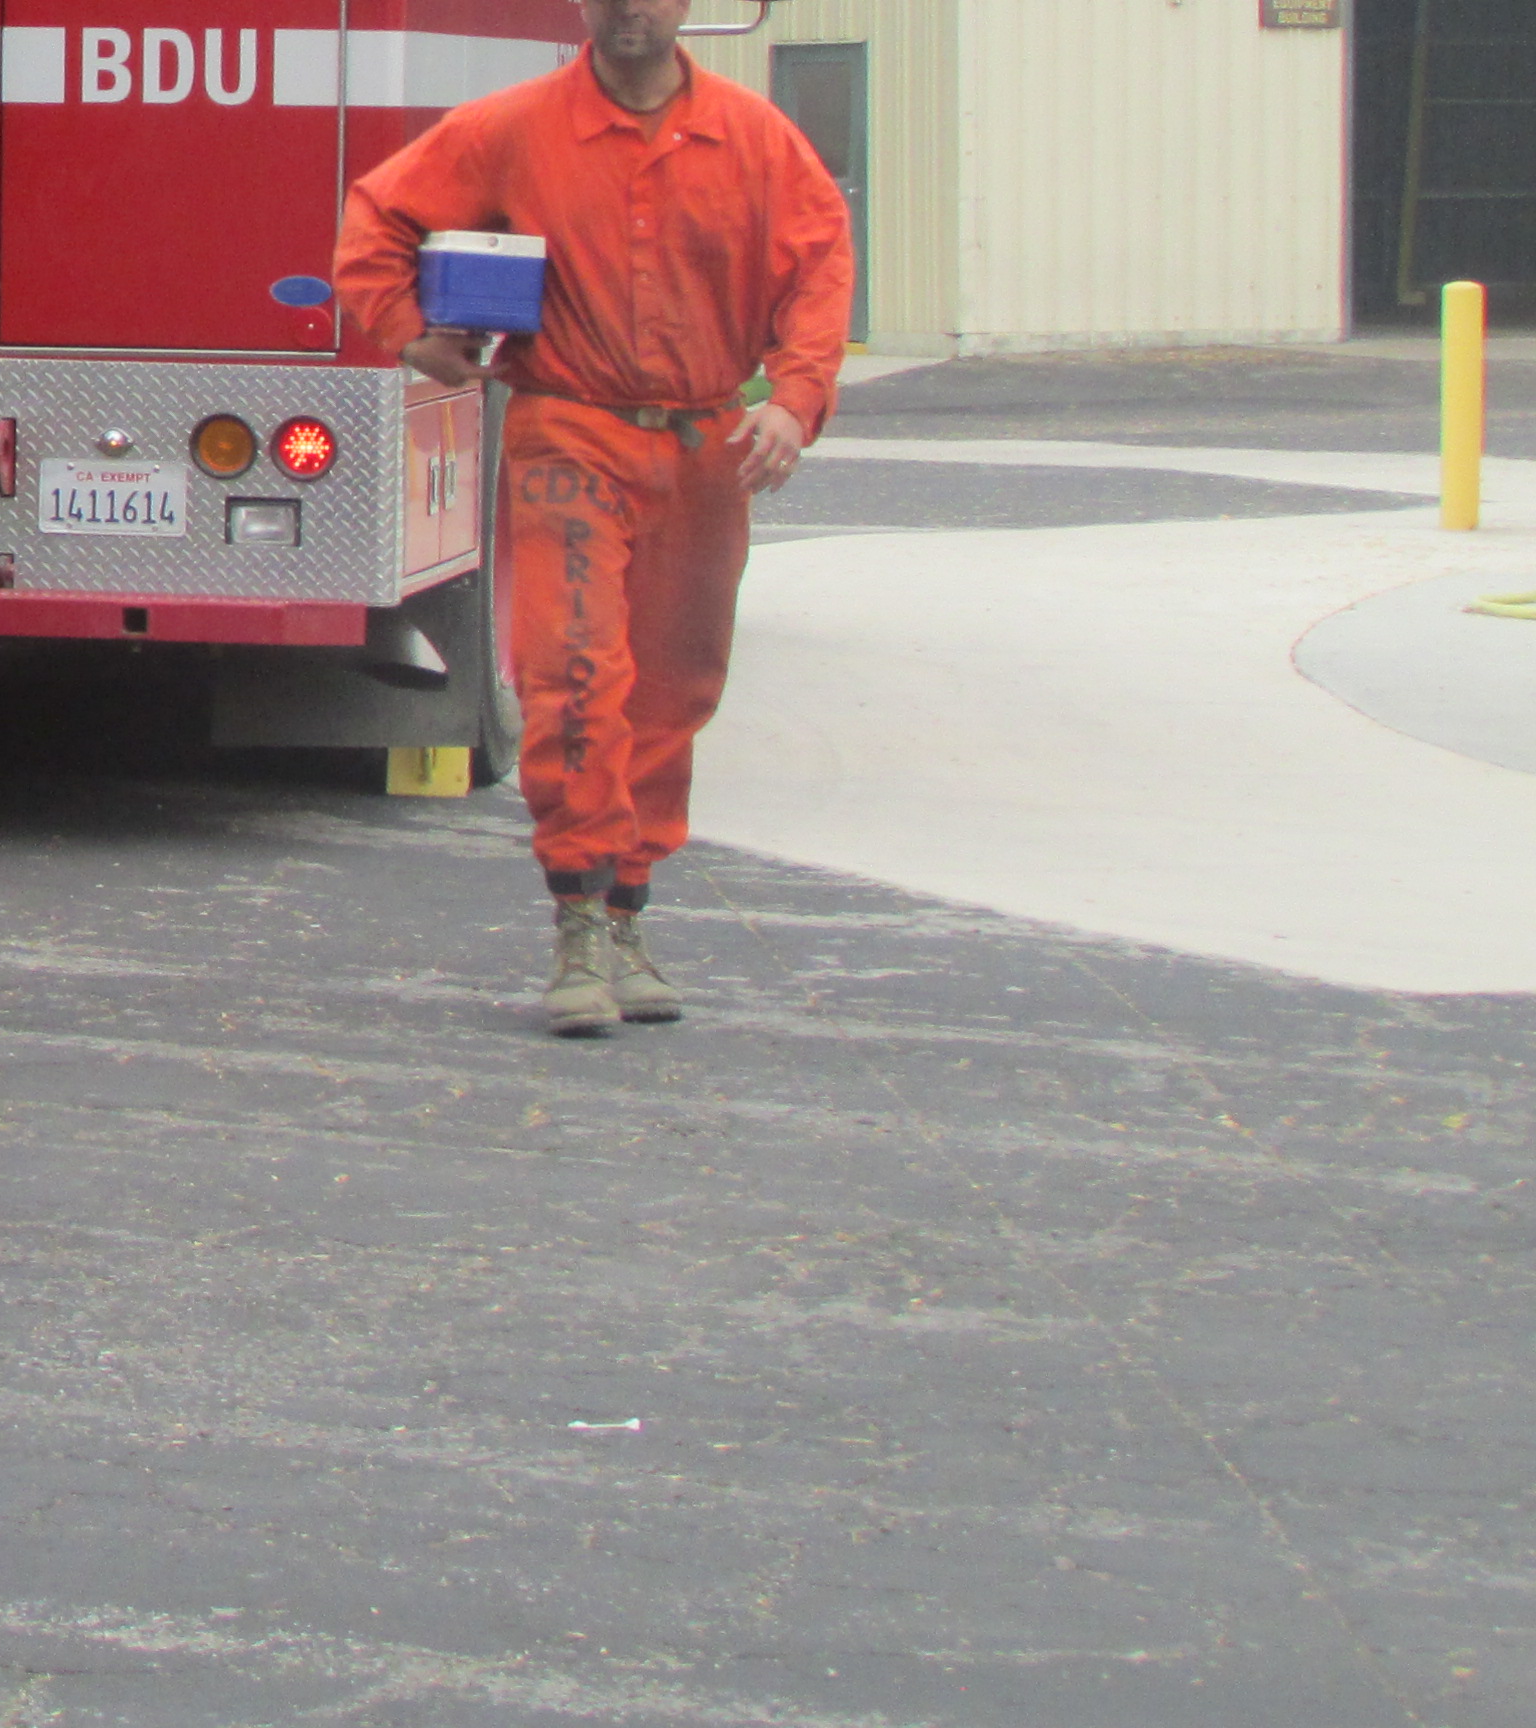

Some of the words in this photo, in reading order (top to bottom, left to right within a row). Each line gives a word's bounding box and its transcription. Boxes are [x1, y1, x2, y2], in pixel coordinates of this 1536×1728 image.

[82, 27, 257, 106] BDU
[76, 472, 95, 482] CA
[101, 472, 152, 483] EXEMPT
[50, 487, 175, 525] 1411614
